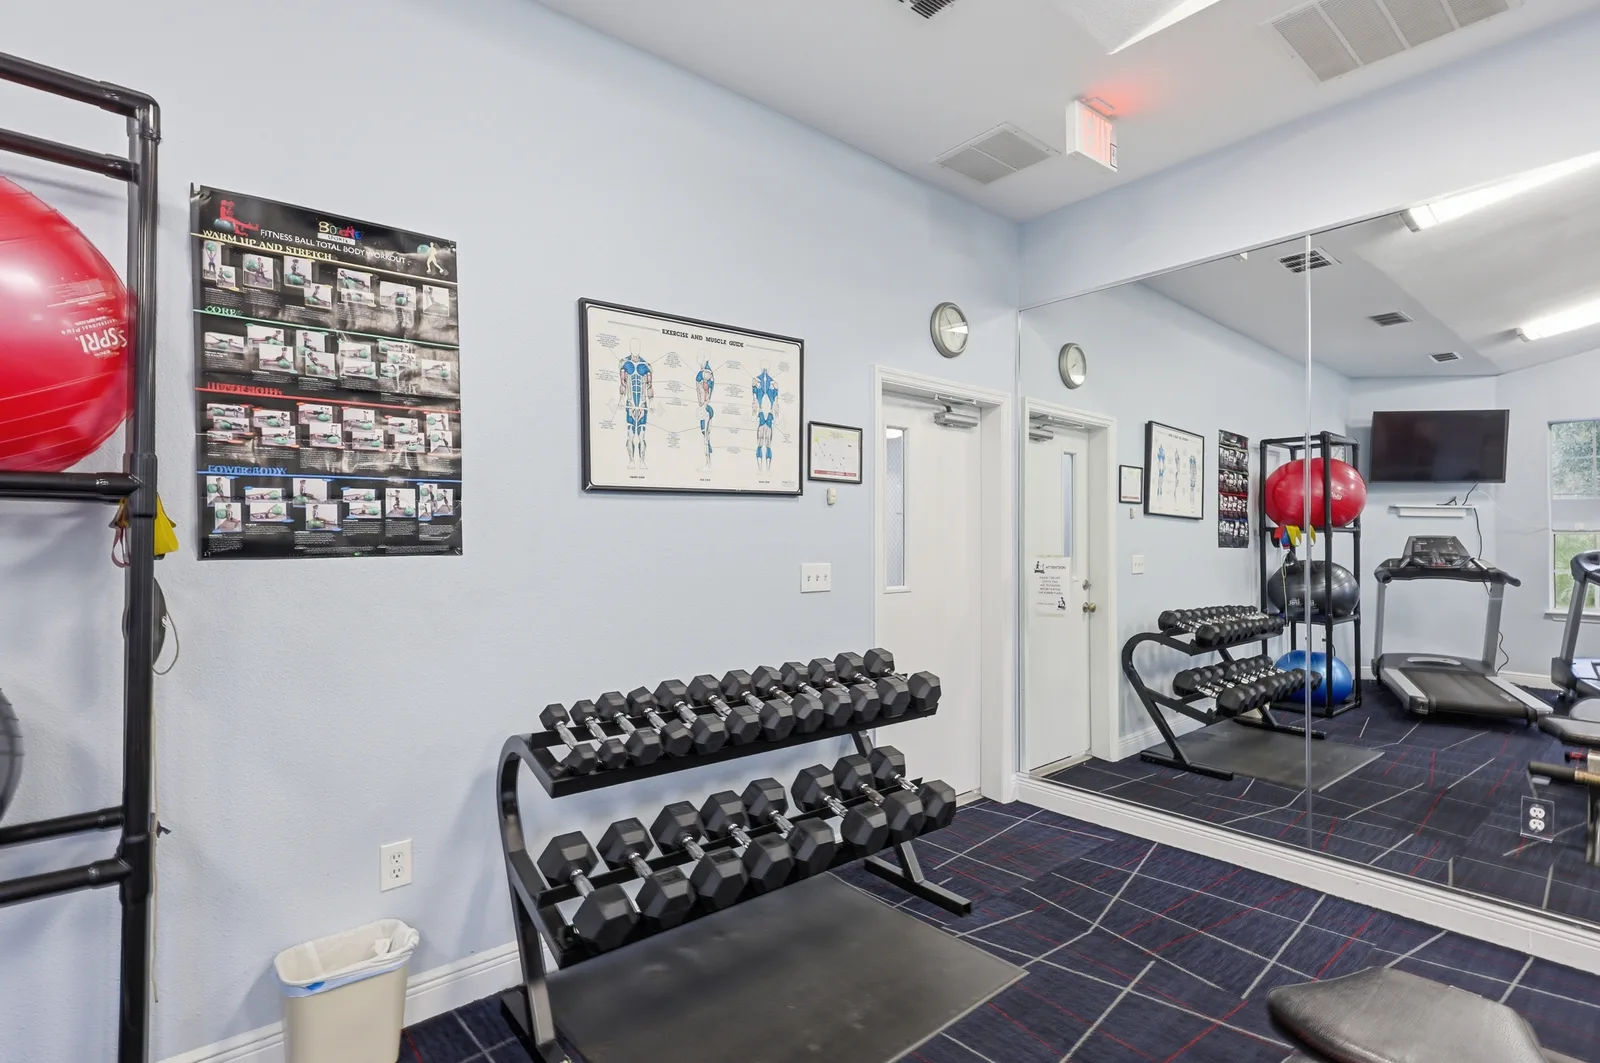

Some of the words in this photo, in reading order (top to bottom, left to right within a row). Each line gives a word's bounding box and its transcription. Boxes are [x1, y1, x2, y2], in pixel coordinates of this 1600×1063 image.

[202, 229, 237, 242] WARM
[239, 236, 257, 246] UP
[259, 241, 283, 252] AND
[285, 245, 333, 260] STRETCH
[260, 229, 292, 242] FITNESS
[294, 235, 315, 246] BALL
[316, 240, 341, 252] TOTAL
[343, 245, 365, 256] BODY
[366, 250, 406, 264] WORKOUT
[79, 327, 120, 354] SPRI
[661, 328, 689, 339] EXERCISE
[690, 333, 703, 341] AND
[705, 336, 727, 345] MUSCLE
